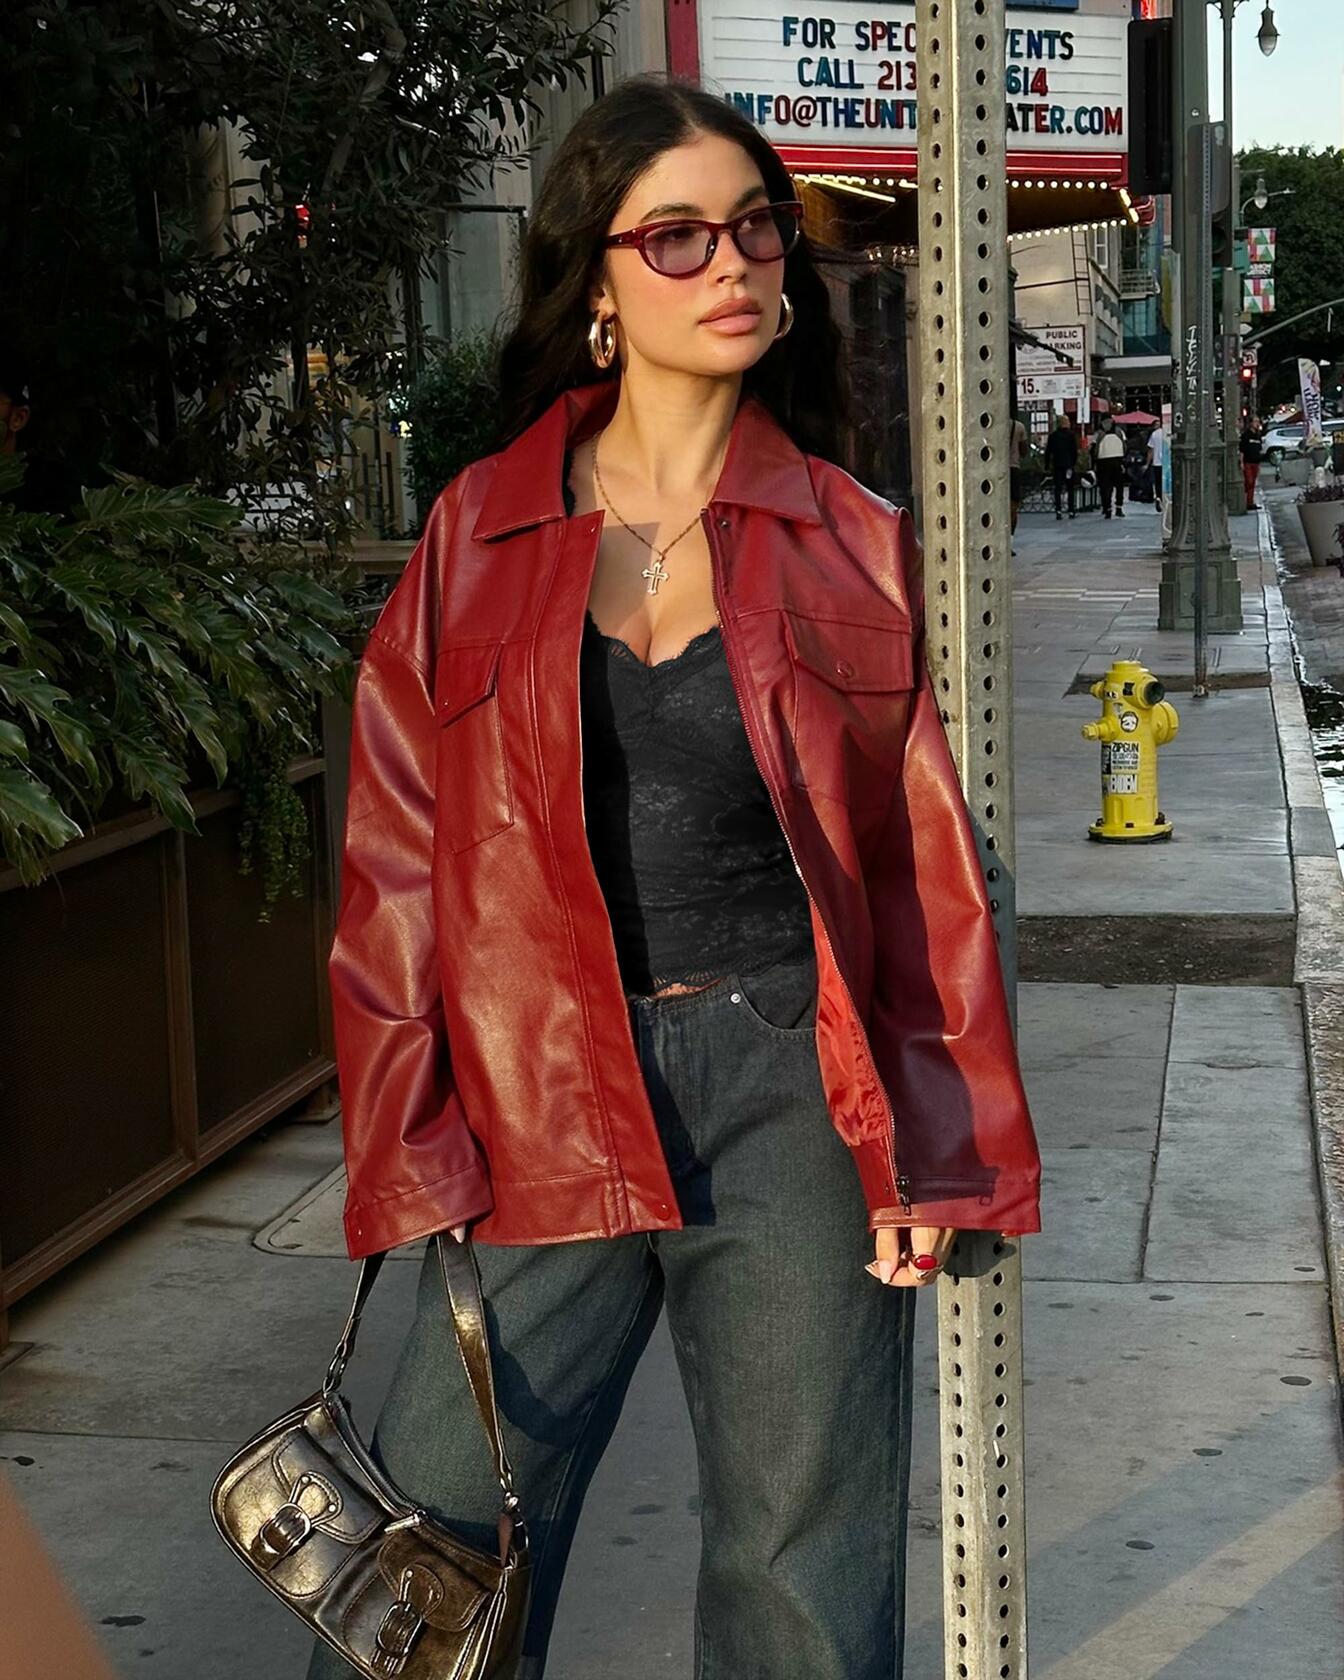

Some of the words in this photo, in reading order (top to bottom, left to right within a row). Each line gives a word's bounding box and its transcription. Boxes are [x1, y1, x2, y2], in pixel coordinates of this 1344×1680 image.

[782, 16, 836, 49] FOR
[1005, 28, 1074, 60] ENTS
[797, 56, 864, 89] CALL
[877, 60, 917, 91] 213
[1006, 64, 1049, 97] 614
[1046, 330, 1078, 339] PUBLIC
